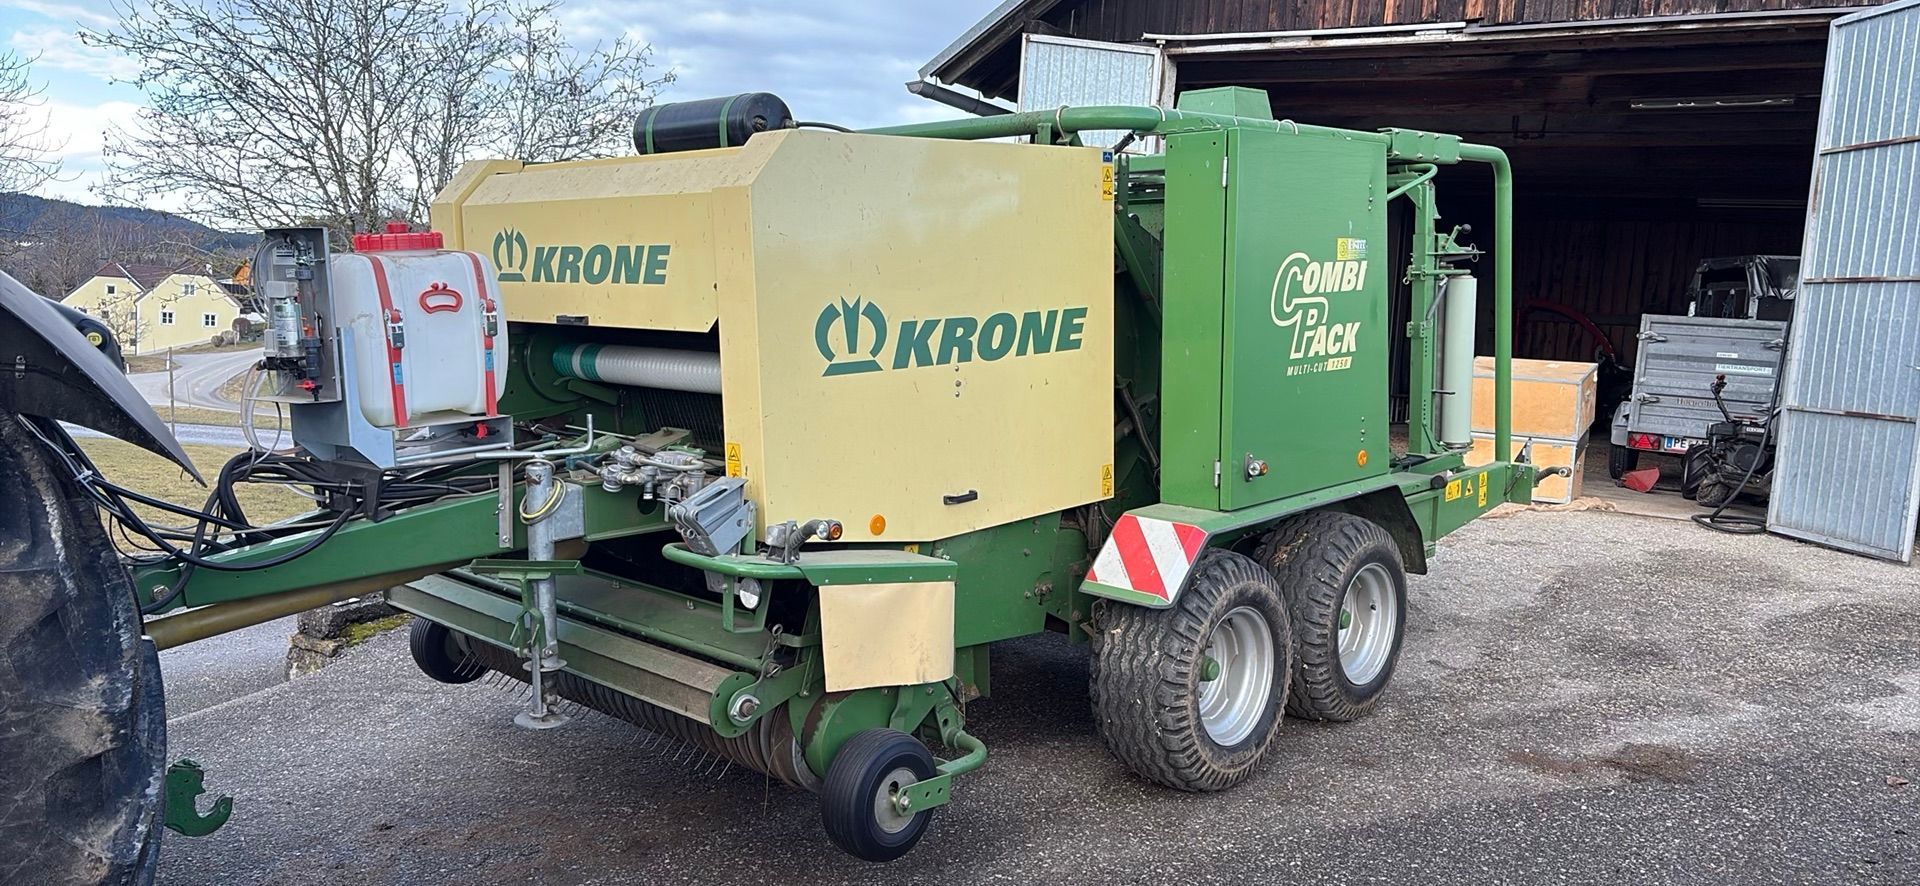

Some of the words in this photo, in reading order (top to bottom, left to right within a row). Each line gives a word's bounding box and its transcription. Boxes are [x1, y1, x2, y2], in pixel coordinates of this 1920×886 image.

[531, 244, 671, 285] KRONE
[1271, 252, 1368, 327] COMBI
[892, 306, 1088, 370] KRONE
[1290, 296, 1361, 360] PACK
[1287, 361, 1328, 376] MULTI-CUT
[1673, 438, 1688, 449] PE
